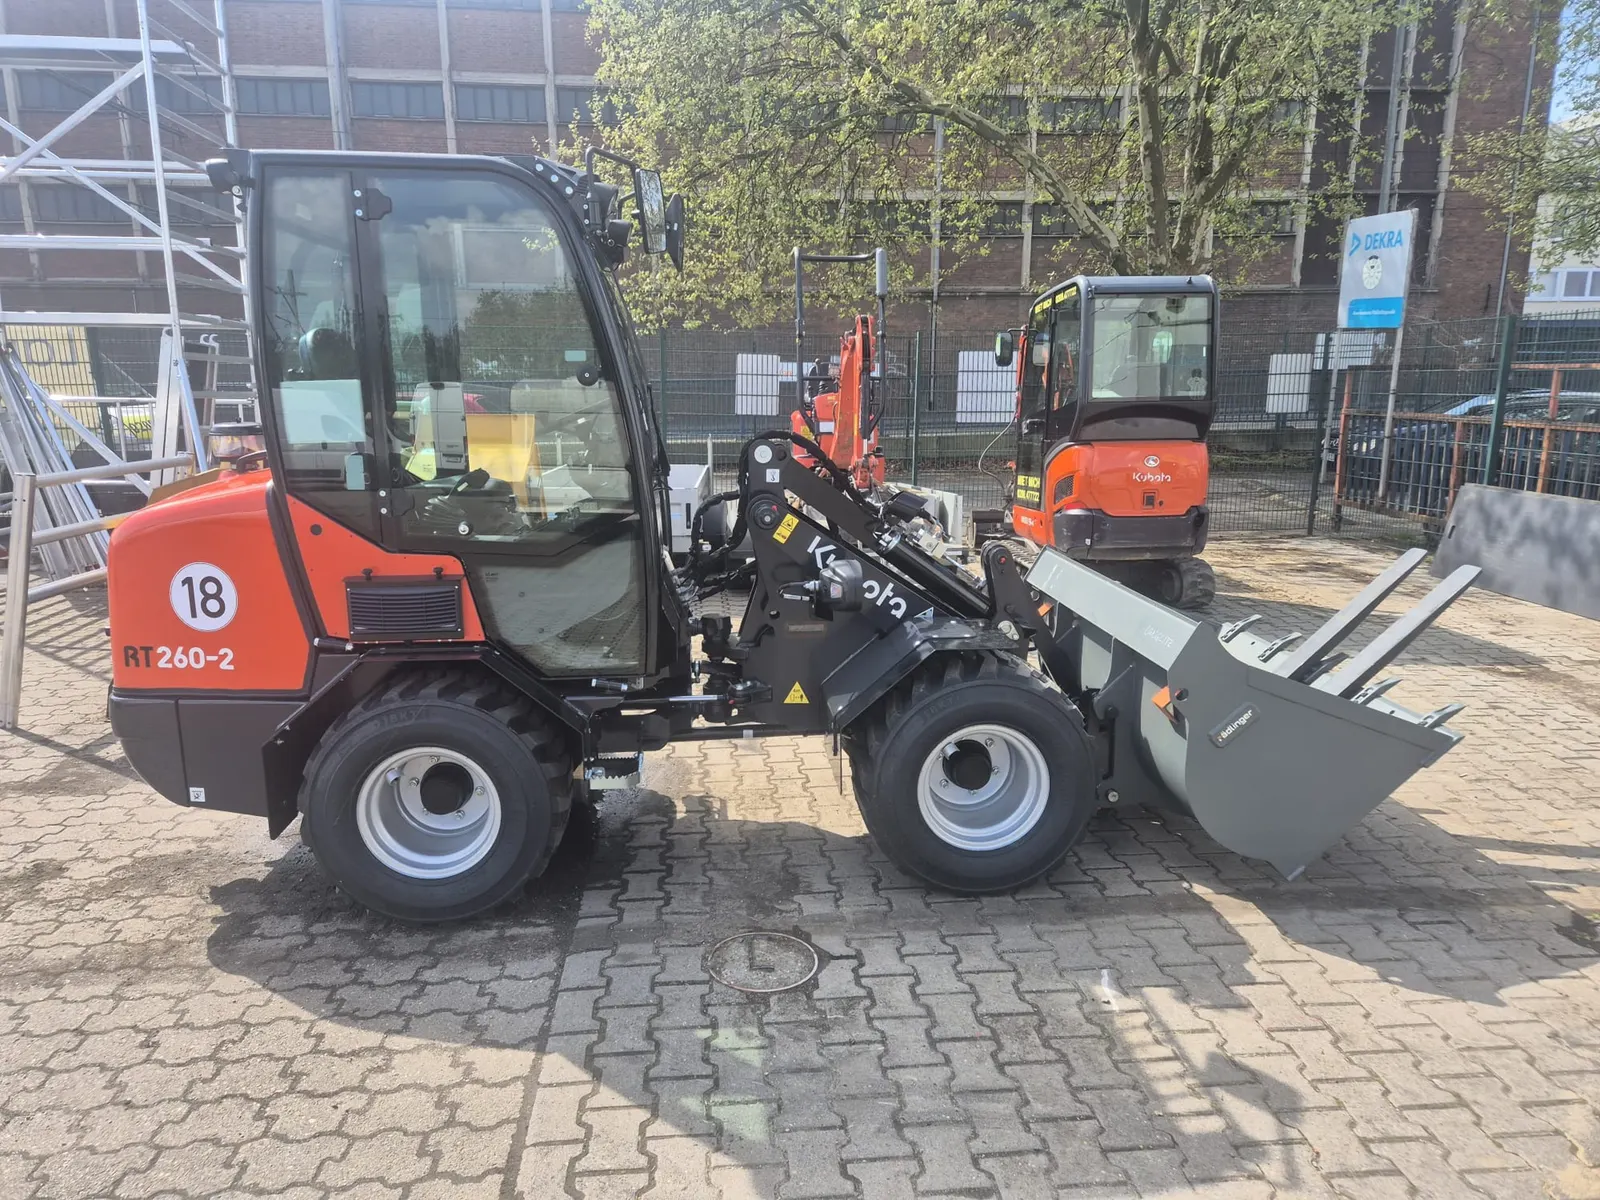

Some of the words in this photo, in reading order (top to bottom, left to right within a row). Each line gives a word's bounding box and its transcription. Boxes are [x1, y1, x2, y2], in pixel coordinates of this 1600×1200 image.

[1364, 229, 1403, 251] DEKRA
[1132, 472, 1171, 483] Kubota
[806, 535, 908, 620] Kota
[181, 575, 226, 619] 18
